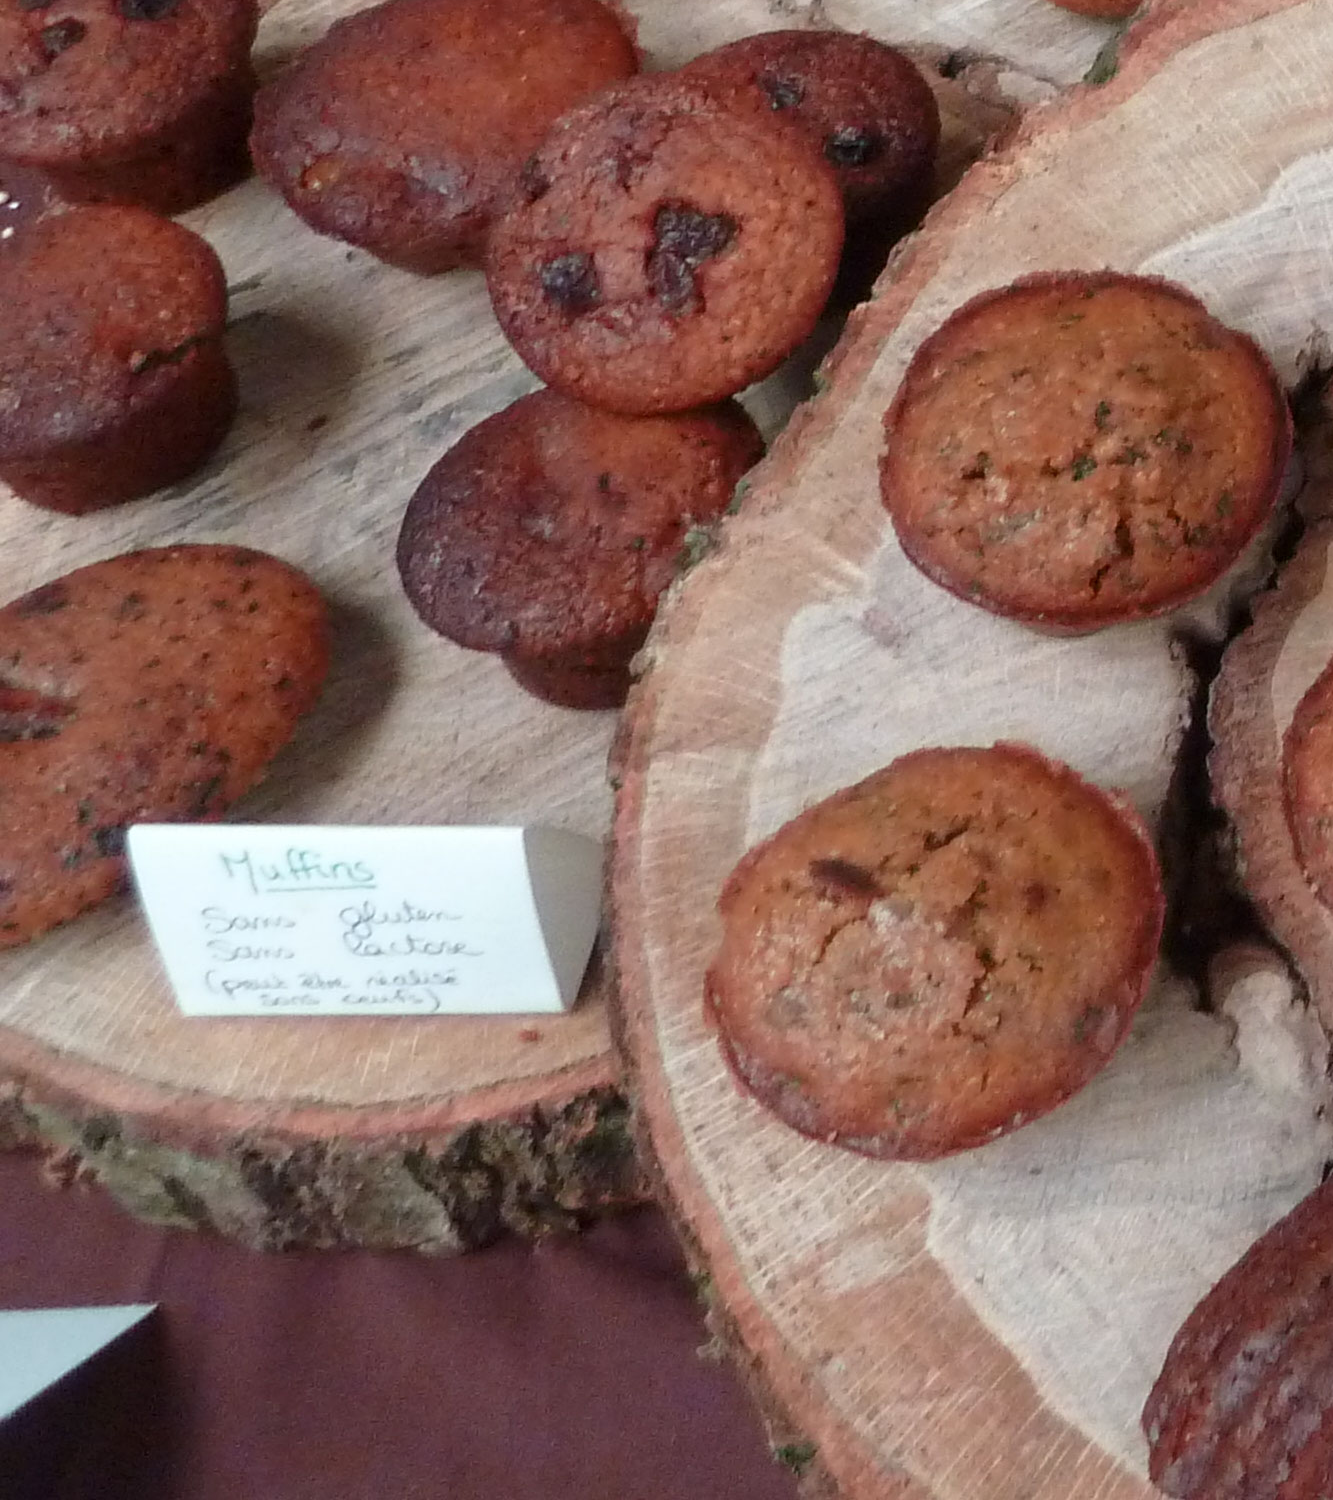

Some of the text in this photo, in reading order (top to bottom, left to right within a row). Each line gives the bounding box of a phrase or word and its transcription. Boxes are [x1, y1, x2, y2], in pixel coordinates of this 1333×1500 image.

[219, 848, 375, 894] Muffins
[201, 899, 463, 939] Sans gluten
[206, 930, 484, 961] Sans lactose
